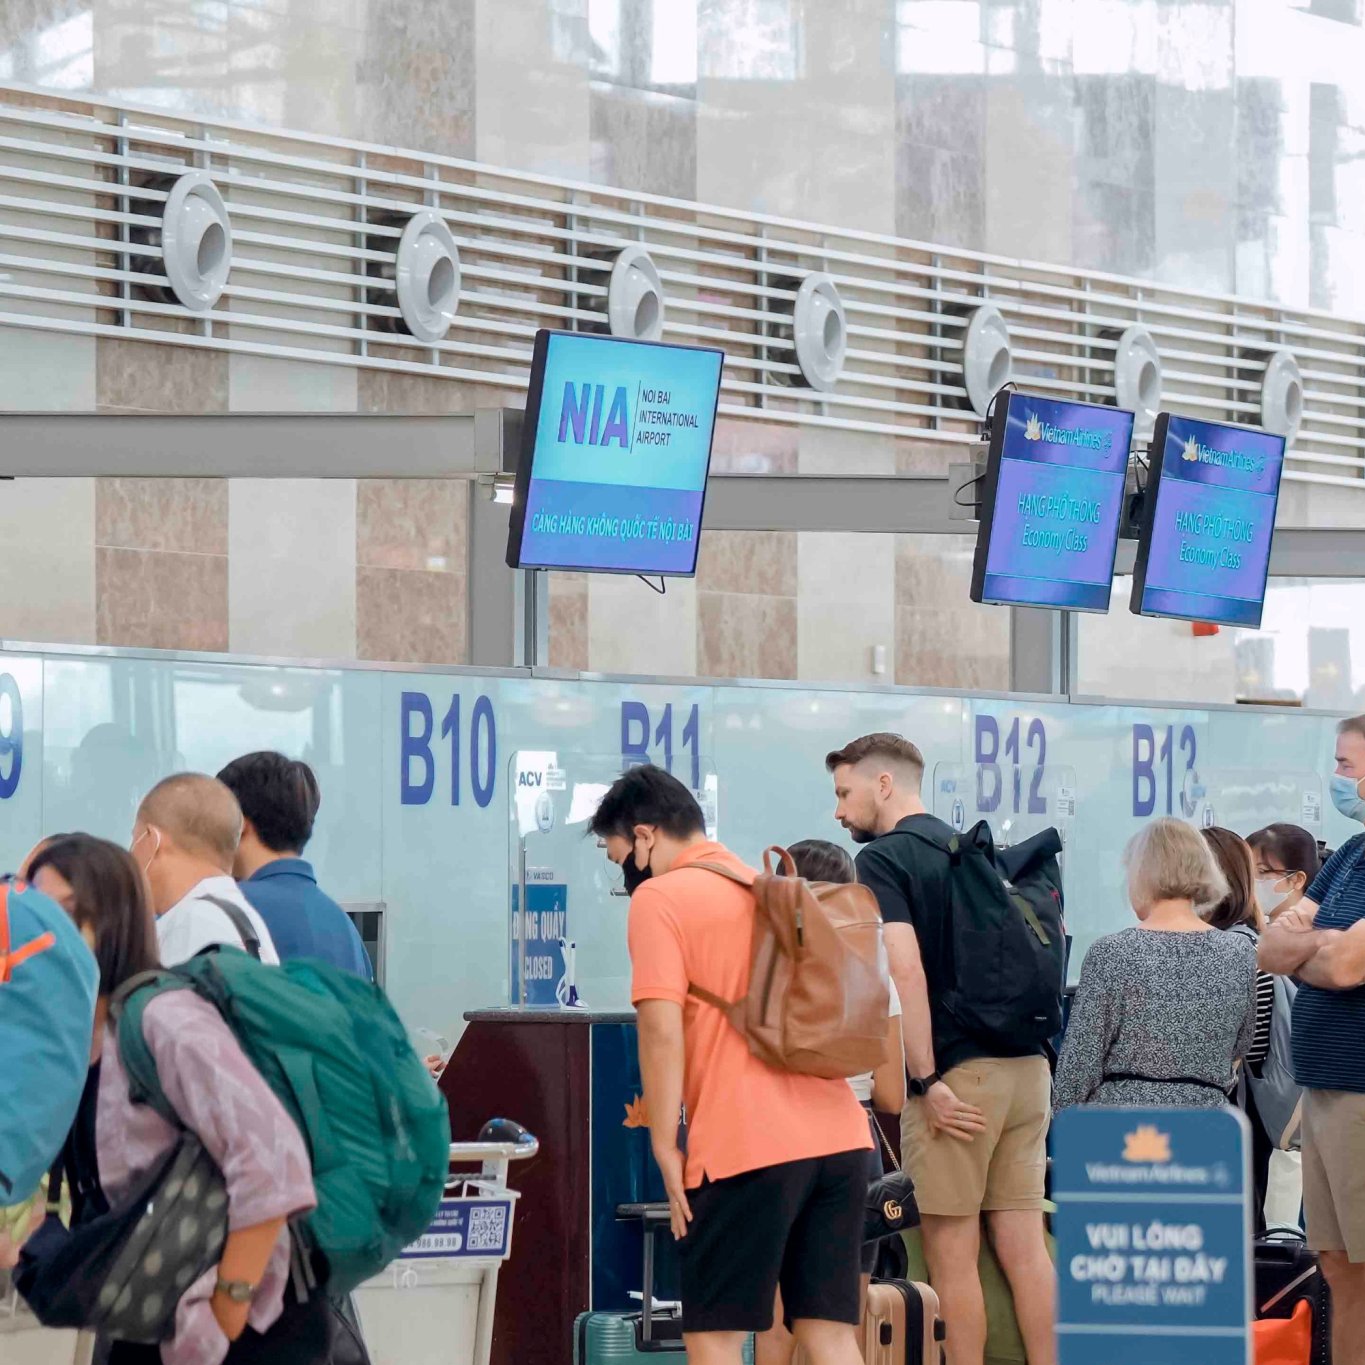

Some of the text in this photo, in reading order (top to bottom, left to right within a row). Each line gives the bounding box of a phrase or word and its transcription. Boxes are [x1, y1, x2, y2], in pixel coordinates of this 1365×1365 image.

[641, 389, 671, 405] NOI BAI
[557, 380, 629, 449] NIA
[639, 410, 699, 428] INTERNATIONAL
[636, 431, 671, 447] AIRPORT
[586, 512, 619, 537] KHÔNG
[619, 513, 646, 542] QUỐC
[646, 515, 659, 540] TẾ
[658, 516, 677, 544] NỘI
[677, 518, 694, 542] BÀI
[1022, 523, 1088, 555] Economy Class
[1179, 540, 1241, 571] Economy Class
[400, 691, 497, 809] B10
[621, 700, 701, 790] B11
[519, 770, 543, 787] ACV
[975, 713, 1048, 815] B12
[1131, 722, 1200, 819] B13
[512, 910, 538, 940] ĐNG
[525, 955, 553, 980] CLOSED
[1086, 1222, 1128, 1249] VUI
[1091, 1283, 1208, 1306] PLEASE WAIT
